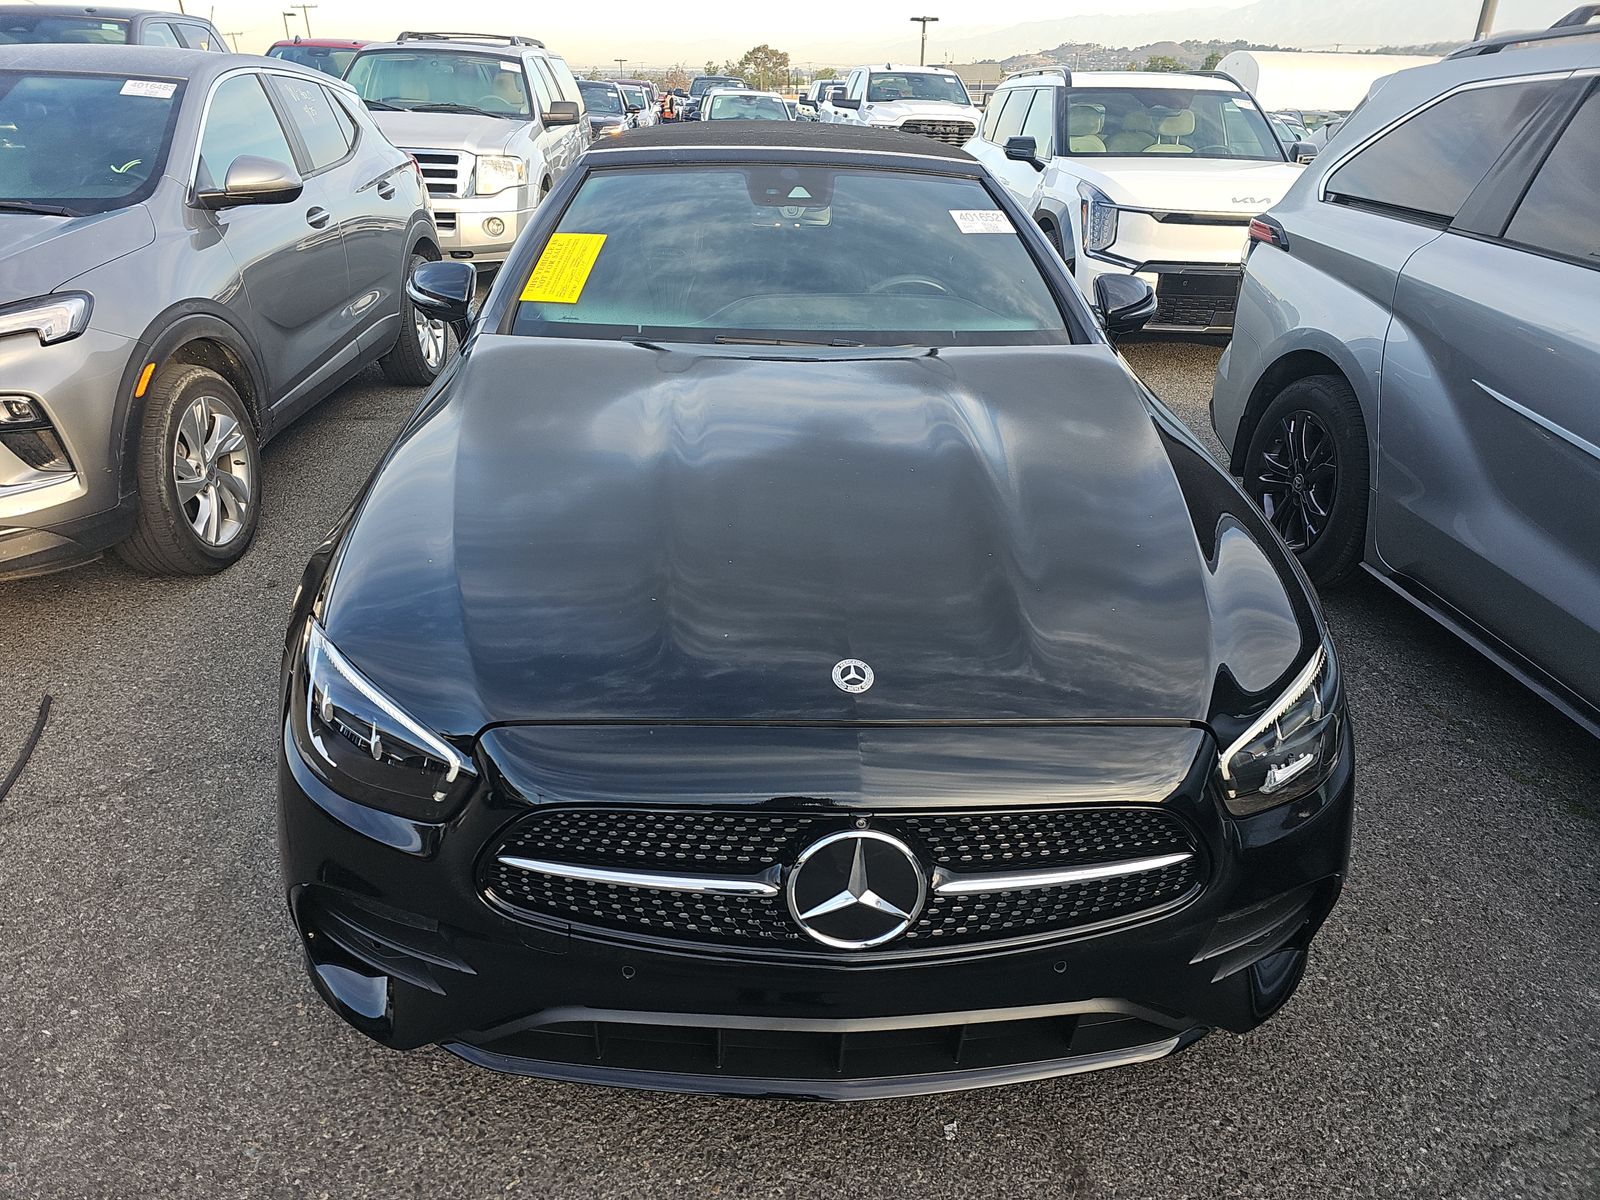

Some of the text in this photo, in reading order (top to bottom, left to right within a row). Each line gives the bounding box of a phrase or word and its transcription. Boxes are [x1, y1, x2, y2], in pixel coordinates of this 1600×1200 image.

[920, 124, 960, 133] RAM
[960, 212, 1007, 222] 4016521
[528, 276, 539, 292] THIS
[536, 246, 555, 274] VEHICLE
[537, 274, 548, 288] NOT
[552, 242, 564, 258] SALE
